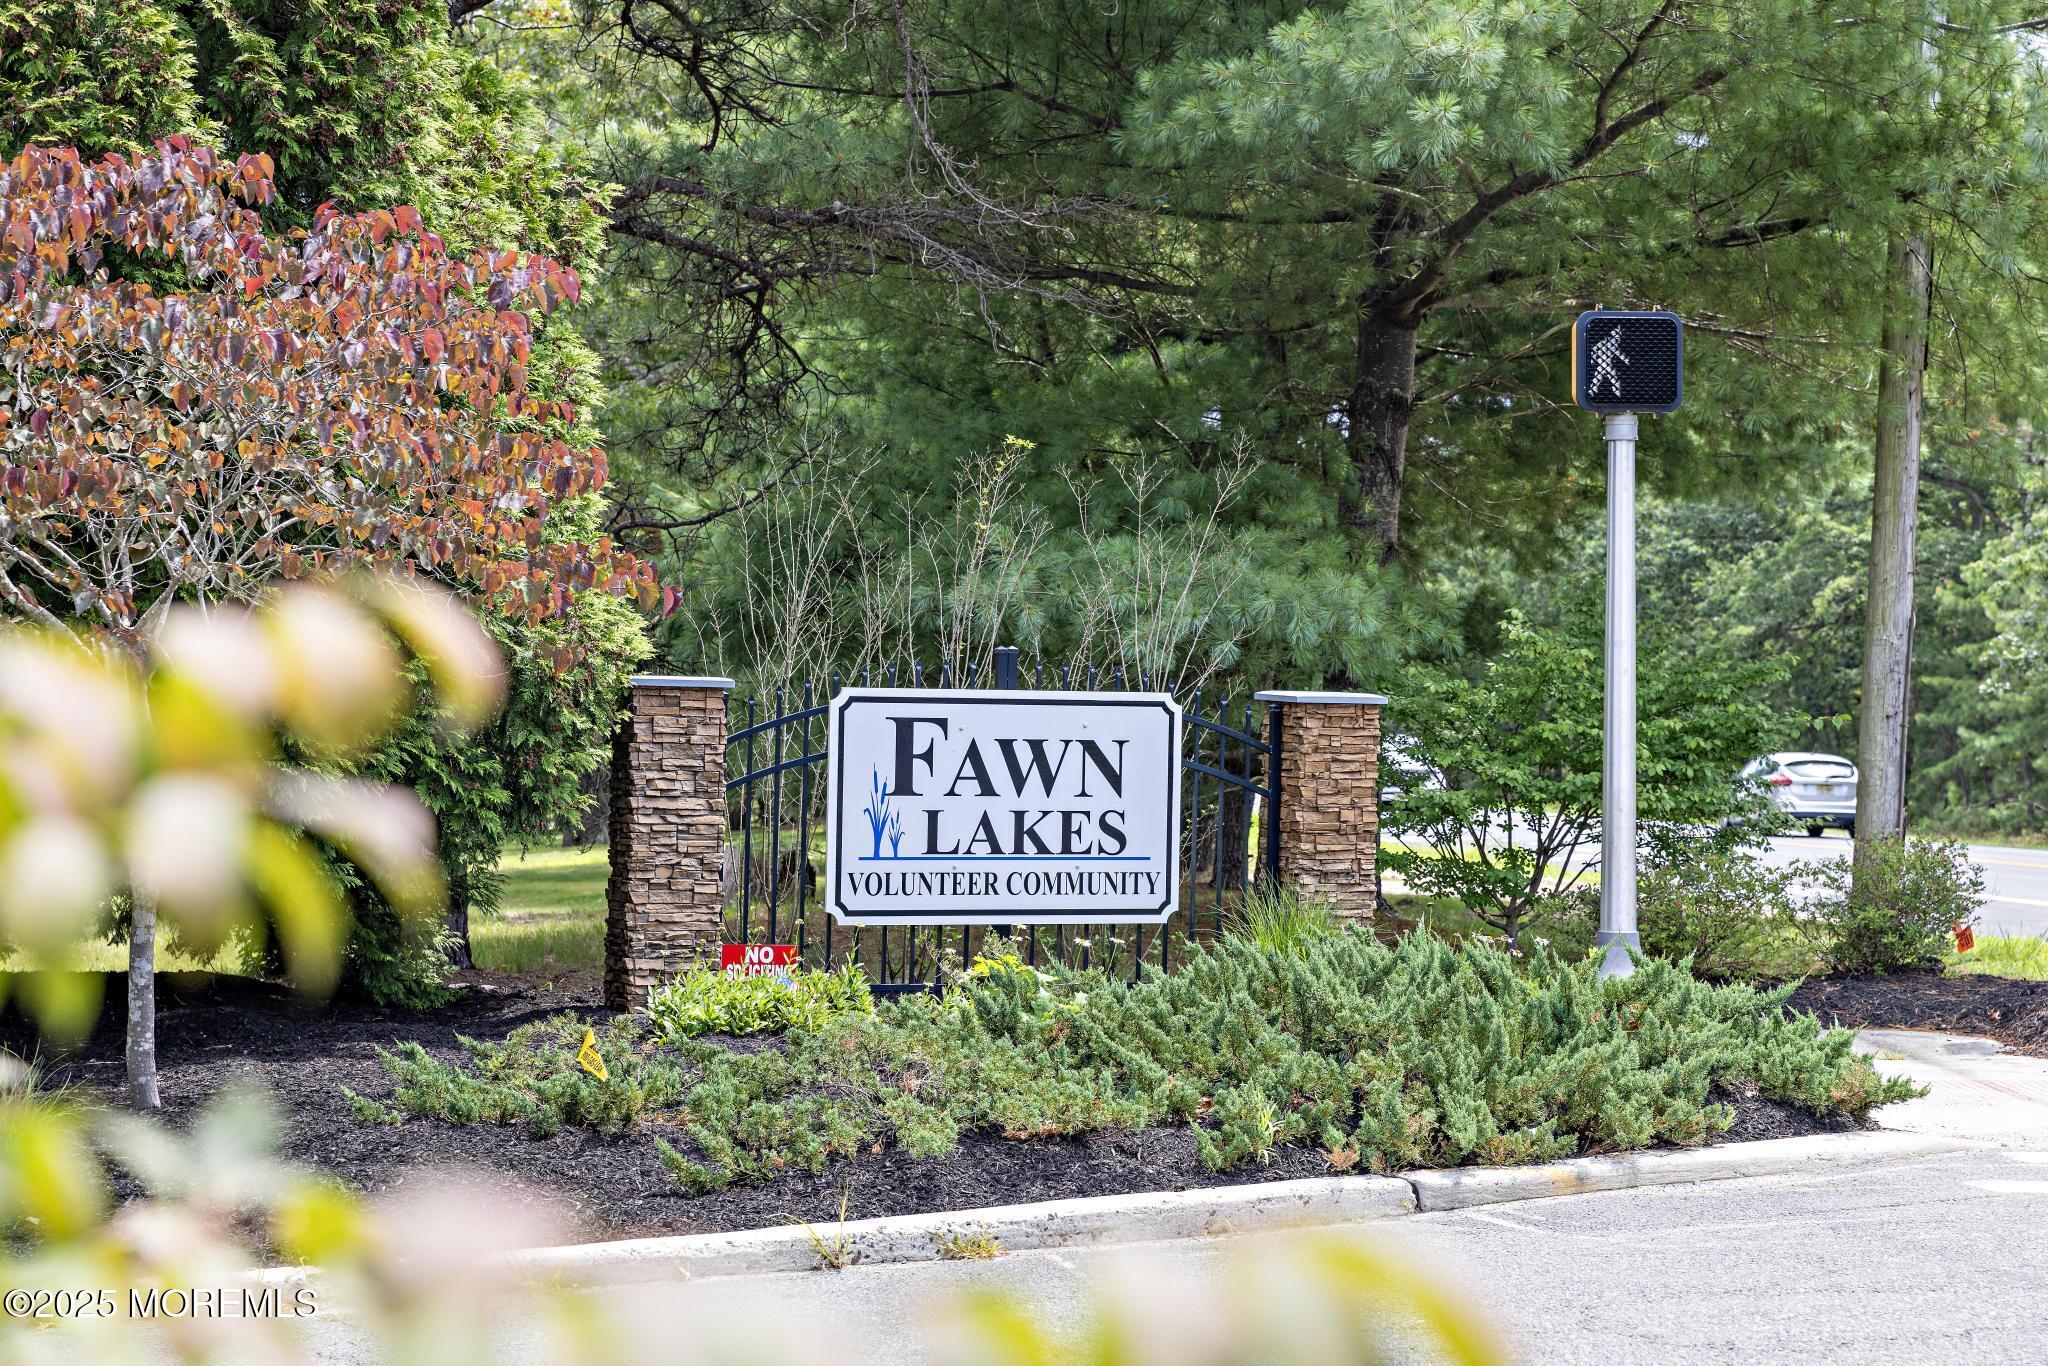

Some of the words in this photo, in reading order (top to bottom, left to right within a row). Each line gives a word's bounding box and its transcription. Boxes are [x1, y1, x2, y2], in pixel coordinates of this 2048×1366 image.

[885, 717, 1130, 799] FAWN
[921, 809, 1128, 856] LAKES
[848, 871, 999, 897] VOLUNTEER
[1006, 871, 1161, 897] COMMUNITY
[745, 946, 774, 964] NO
